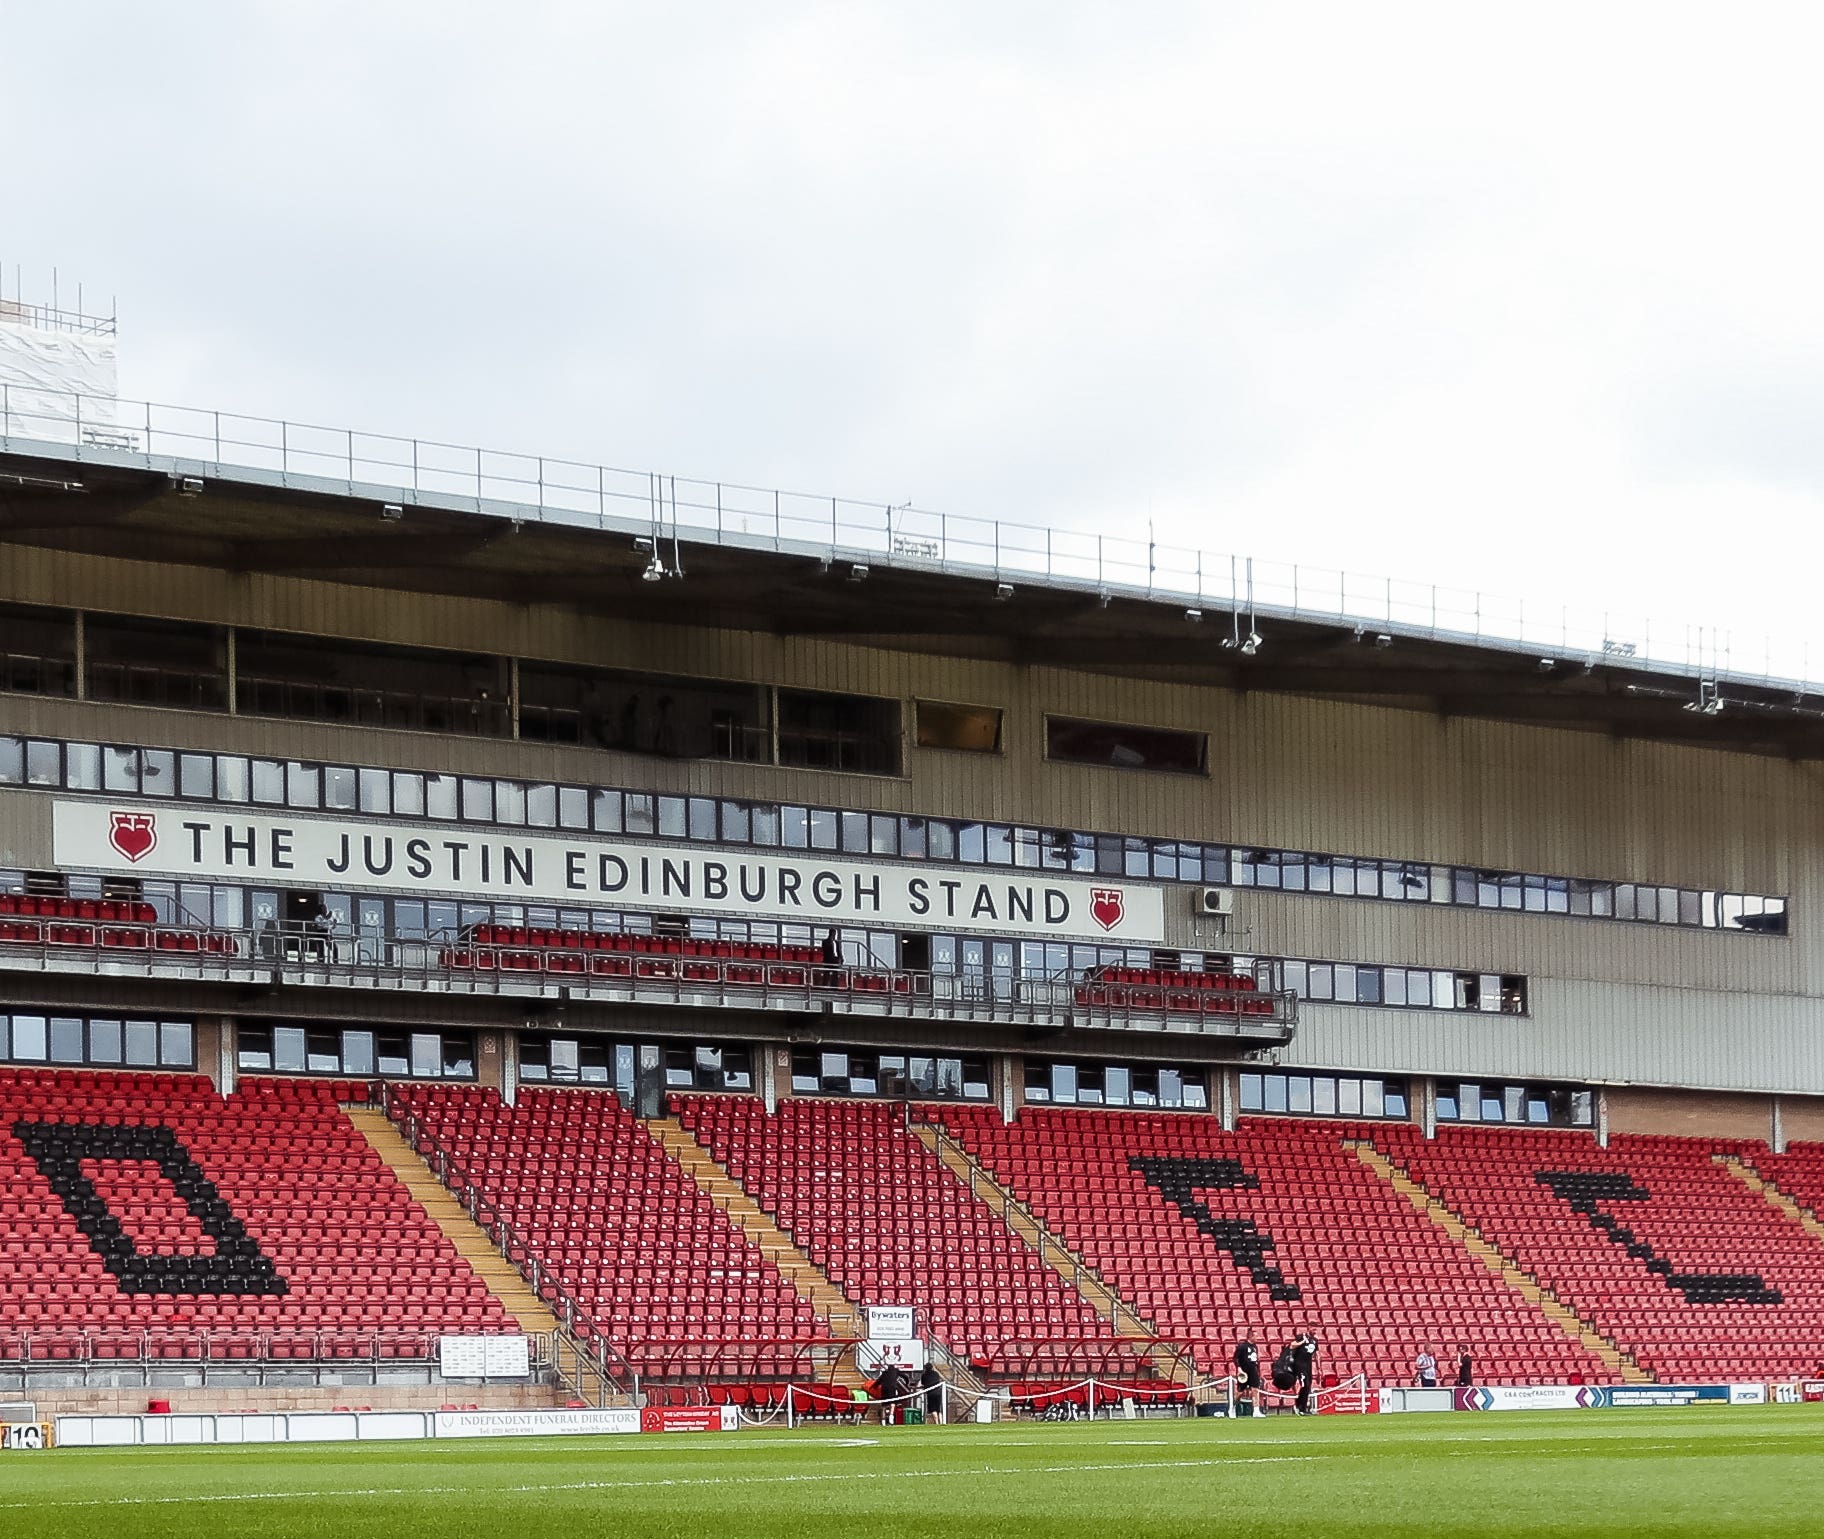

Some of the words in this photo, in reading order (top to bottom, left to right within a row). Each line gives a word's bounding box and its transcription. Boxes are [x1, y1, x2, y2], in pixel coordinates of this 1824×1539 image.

[183, 821, 294, 869] THE
[325, 833, 534, 887] JUSTIN
[565, 851, 881, 912] EDINBURGH
[908, 877, 1071, 924] STAND
[460, 1414, 534, 1426] INDEPENDENT
[534, 1413, 578, 1425] FUNERAL
[580, 1412, 637, 1424] DIRECTORS
